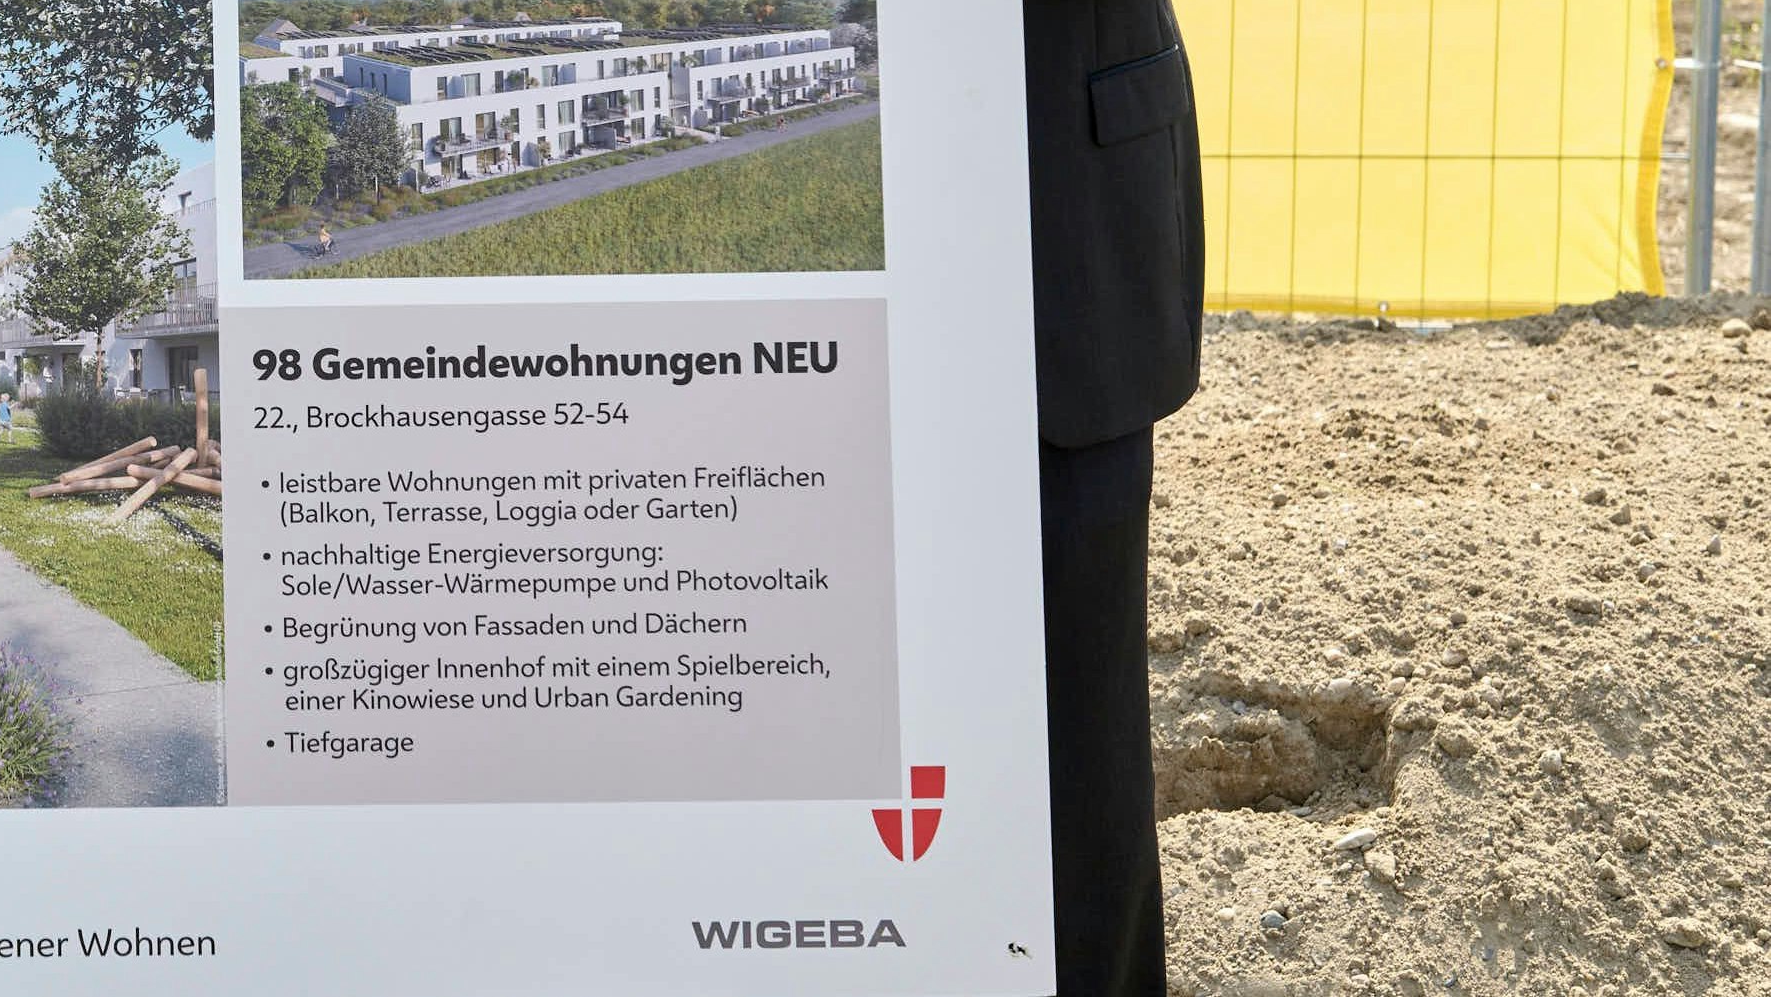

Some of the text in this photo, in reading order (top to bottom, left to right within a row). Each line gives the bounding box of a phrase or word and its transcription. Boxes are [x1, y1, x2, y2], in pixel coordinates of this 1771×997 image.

[252, 340, 838, 386] 98 Gemeindewohnungen NEU
[254, 402, 629, 434] 22., Brockhausengasse 52-54
[280, 465, 825, 498] leistbare Wohnungen mit privaten Freiflächen
[280, 495, 738, 528] (Balkon, Terrasse, Loggia oder Garten)
[281, 542, 663, 571] nachhaltige Energieversorgung:
[282, 567, 829, 600] Sole/Wasser-Wärmepumpe und Photovoltaik
[283, 611, 747, 645] Begrünung von Fassaden und Dächern
[283, 652, 830, 687] großzügiger Innenhof mit einem Spielbereich,
[285, 684, 743, 713] einer Kinowiese und Urban Gardening
[284, 730, 414, 760] Tiefgarage
[77, 926, 216, 957] Wohnen
[691, 919, 907, 950] WIGEBA
